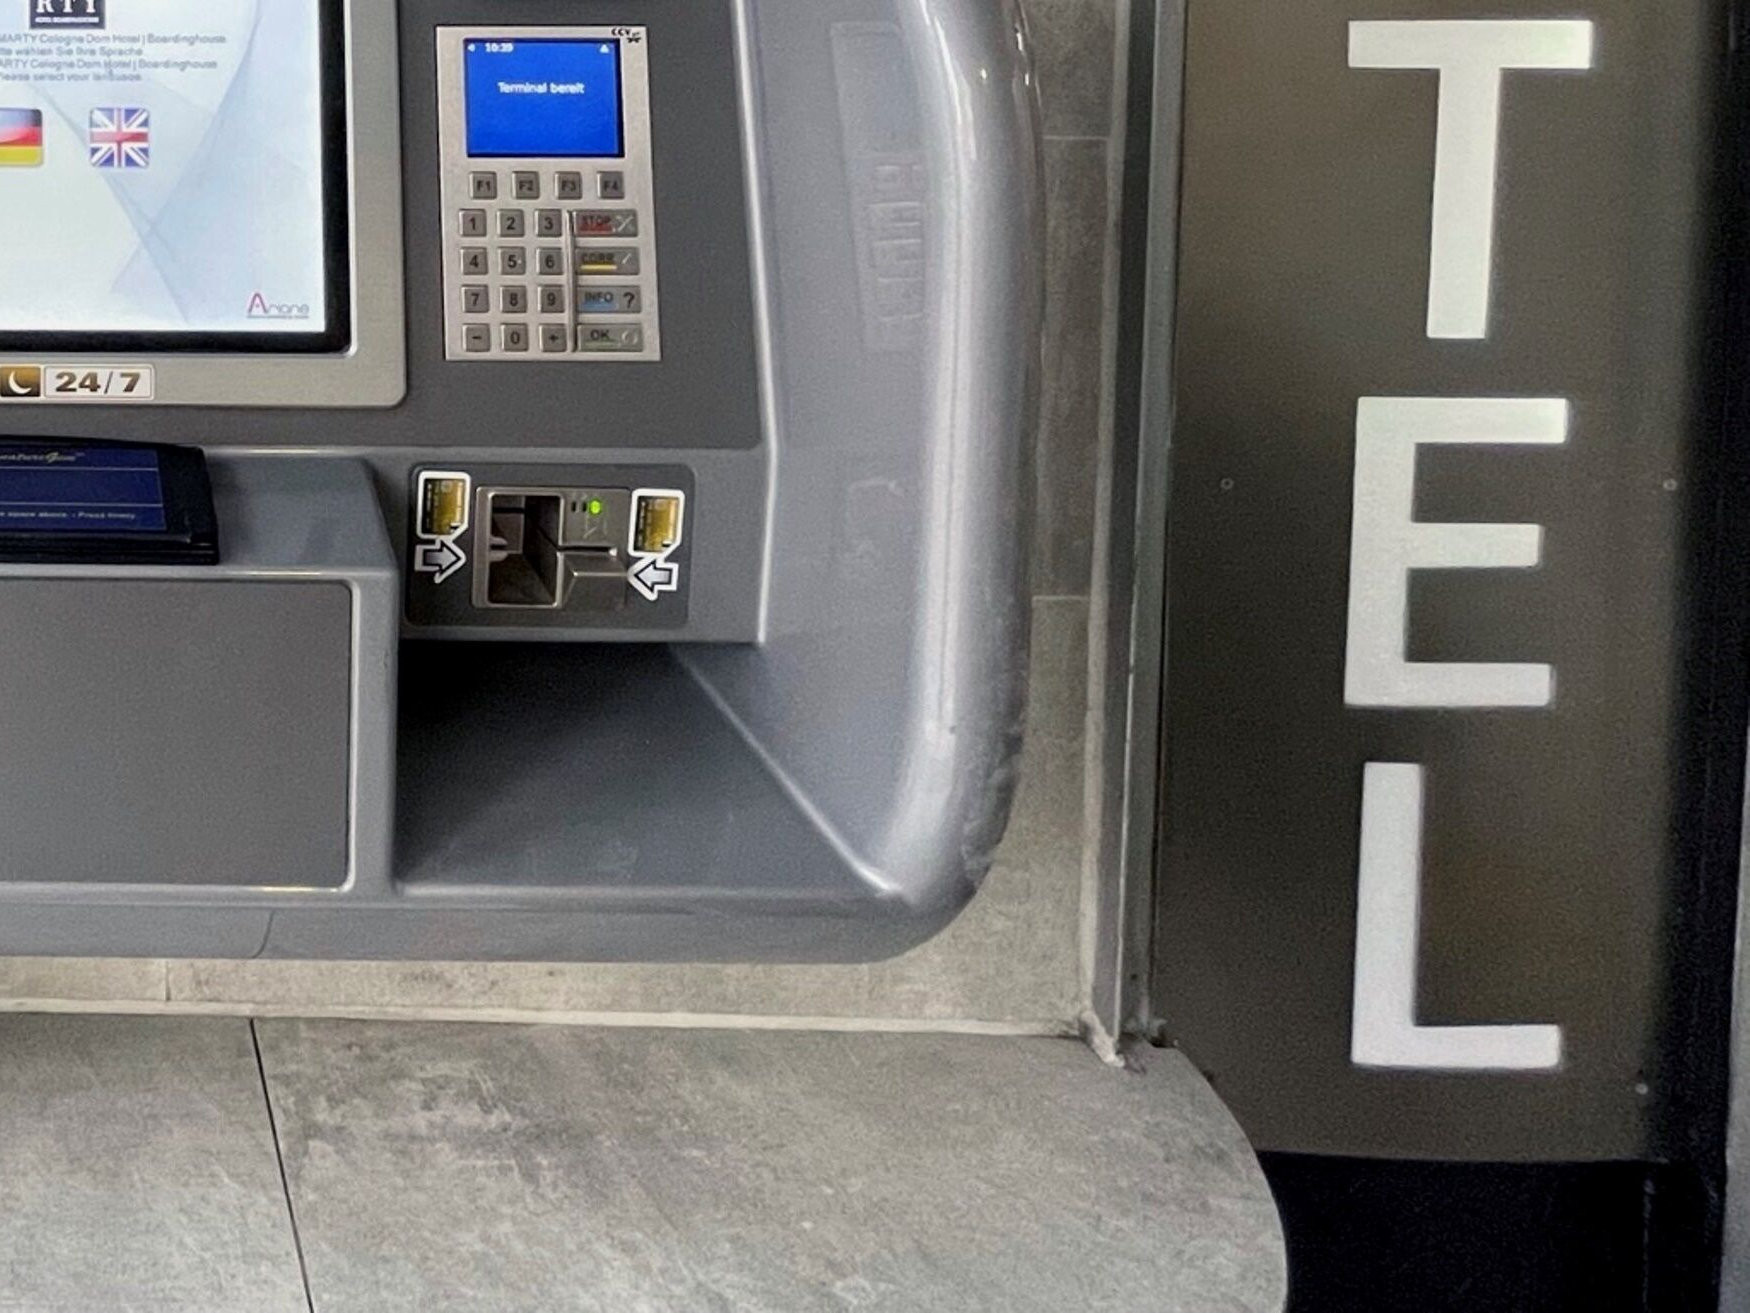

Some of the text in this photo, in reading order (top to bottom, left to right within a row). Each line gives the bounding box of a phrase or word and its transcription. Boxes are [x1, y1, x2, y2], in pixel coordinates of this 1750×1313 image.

[39, 33, 84, 46] Cologne
[86, 33, 111, 43] Dom
[112, 33, 140, 43] Hotel
[147, 33, 227, 46] Boardinghouse
[56, 46, 73, 55] Sie
[76, 46, 96, 55] Ihre
[99, 46, 143, 57] Sprache
[30, 59, 74, 71] Cologne
[76, 59, 100, 69] Dom
[104, 58, 132, 69] Hotel
[138, 59, 218, 71] Boardinghouse
[33, 72, 65, 81] select
[67, 73, 89, 82] your
[498, 82, 585, 94] Terminal bereit
[476, 180, 491, 191] F1
[519, 180, 534, 191] F2
[561, 180, 576, 190] F3
[603, 180, 619, 190] F4
[469, 217, 476, 230] 1
[506, 217, 515, 230] 2
[544, 217, 553, 230] 3
[581, 216, 611, 225] STOP
[469, 255, 479, 268] 4
[508, 255, 516, 268] 5
[545, 255, 554, 268] 6
[471, 293, 479, 306] 7
[509, 293, 518, 306] 8
[547, 293, 556, 306] 9
[584, 292, 613, 303] INFO
[510, 331, 520, 344] 0
[590, 329, 611, 341] OK
[55, 371, 141, 394] 24/7
